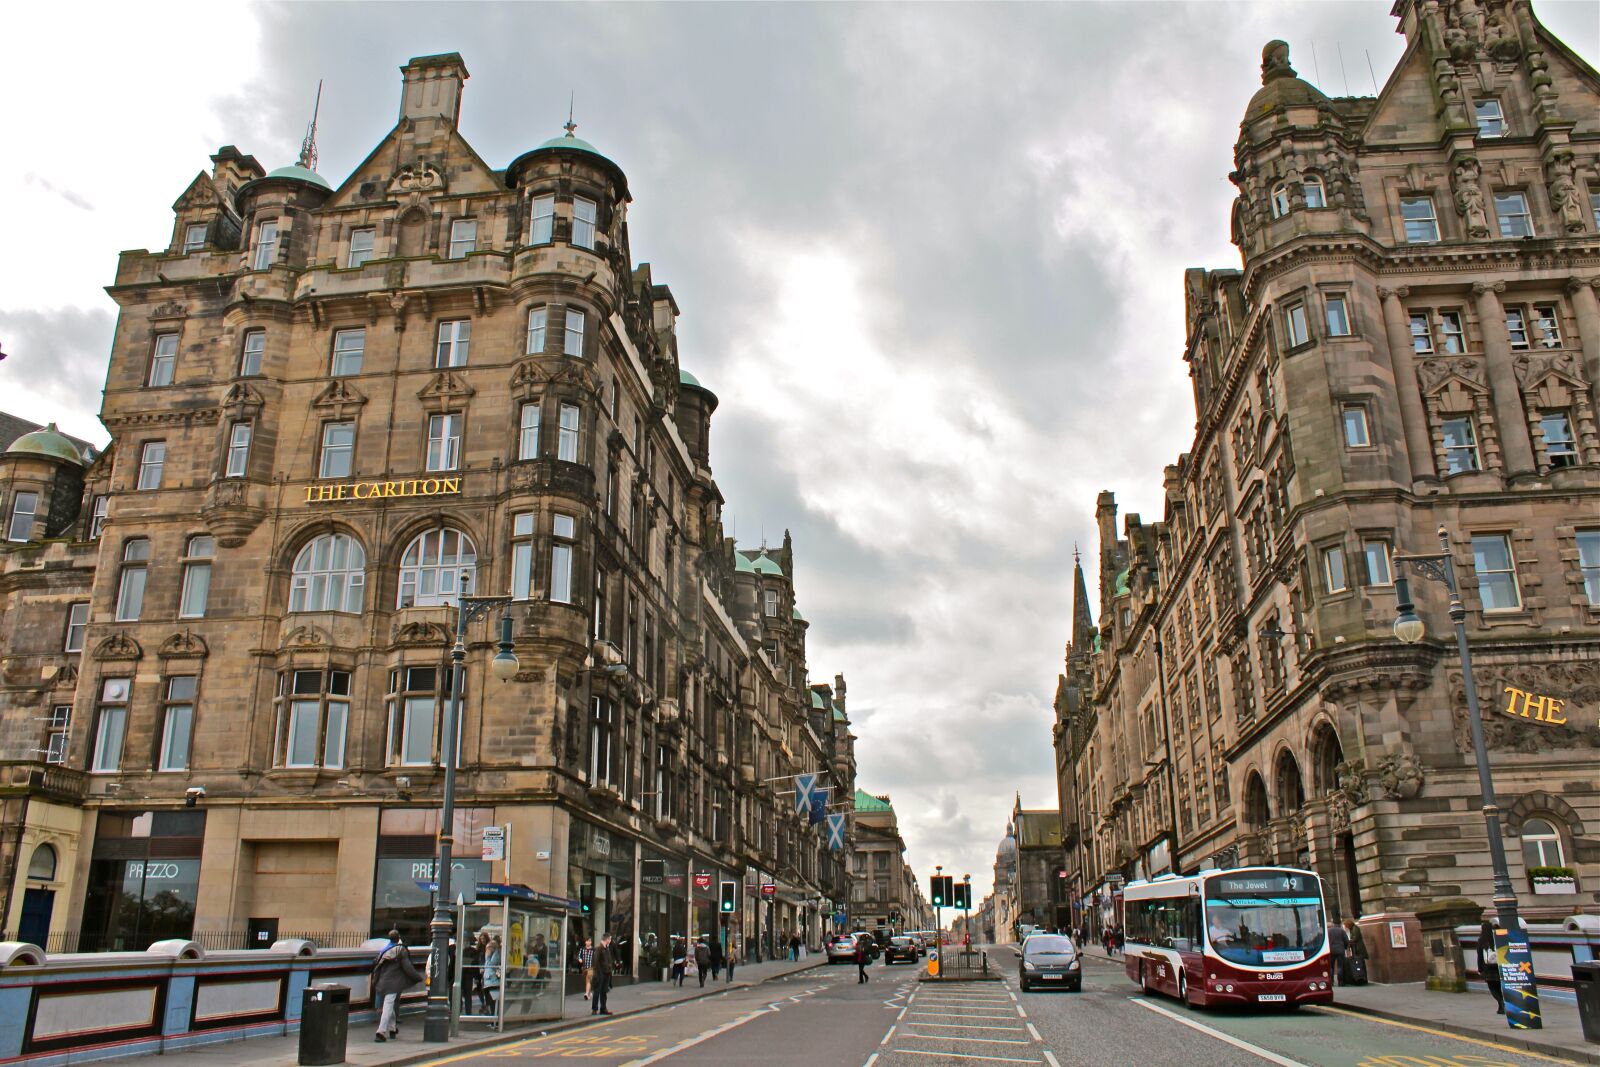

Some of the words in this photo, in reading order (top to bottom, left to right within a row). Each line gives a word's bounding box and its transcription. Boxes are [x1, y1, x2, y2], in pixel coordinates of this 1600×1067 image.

[304, 486, 347, 502] THE
[353, 478, 462, 499] CARLTON
[1504, 687, 1567, 725] THE
[129, 863, 179, 878] PREZZO
[1228, 881, 1244, 889] The
[1246, 881, 1268, 889] Jewel
[1282, 878, 1297, 889] 49
[487, 1046, 647, 1057] STOP
